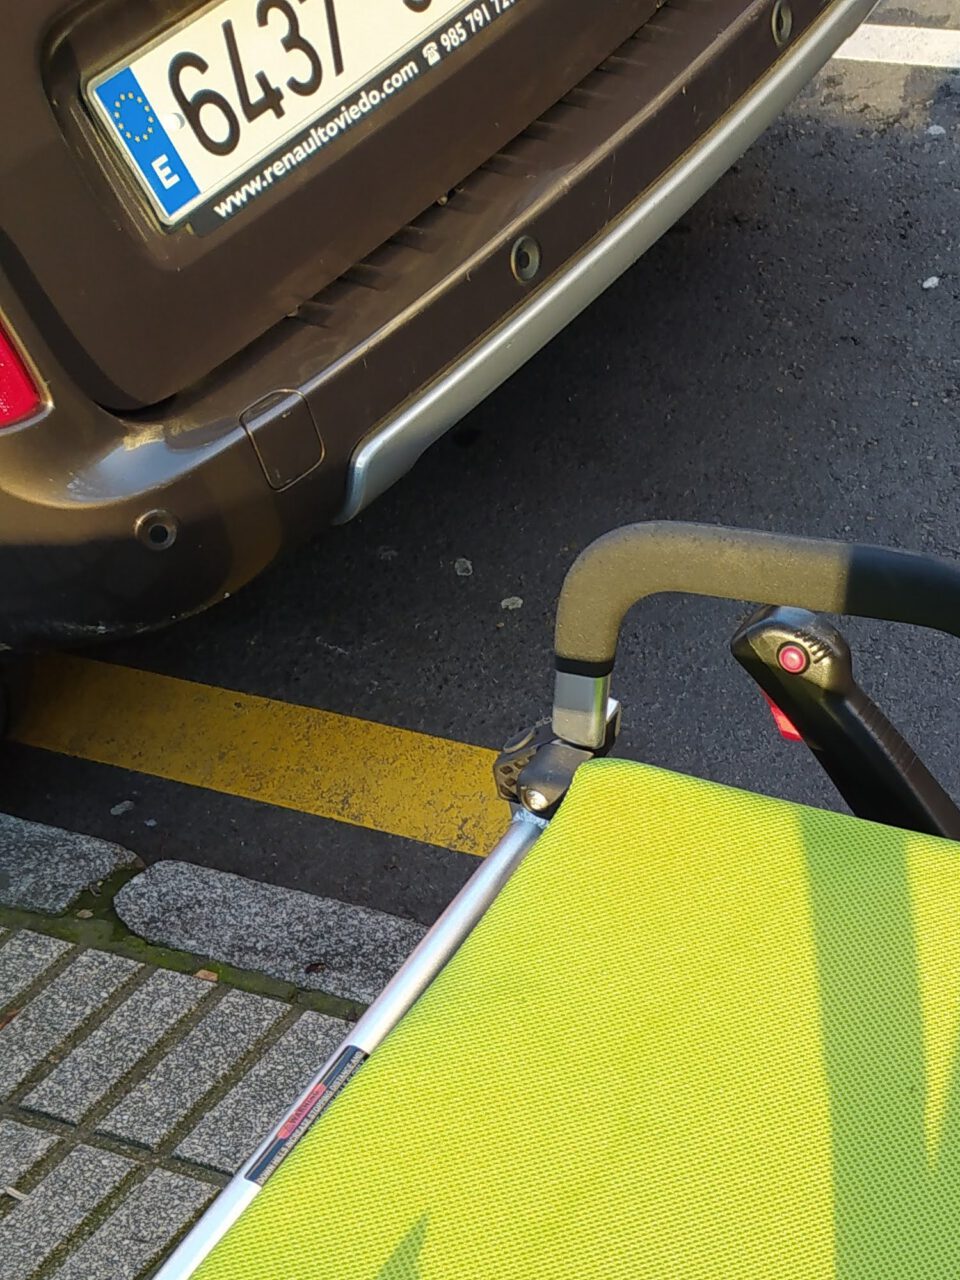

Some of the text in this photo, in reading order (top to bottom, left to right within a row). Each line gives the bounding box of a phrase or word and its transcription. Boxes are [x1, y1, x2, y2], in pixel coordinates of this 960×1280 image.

[151, 153, 181, 190] E
[213, 60, 419, 218] www.renaultoviedo.com
[440, 21, 467, 52] 985
[465, 3, 491, 33] 791
